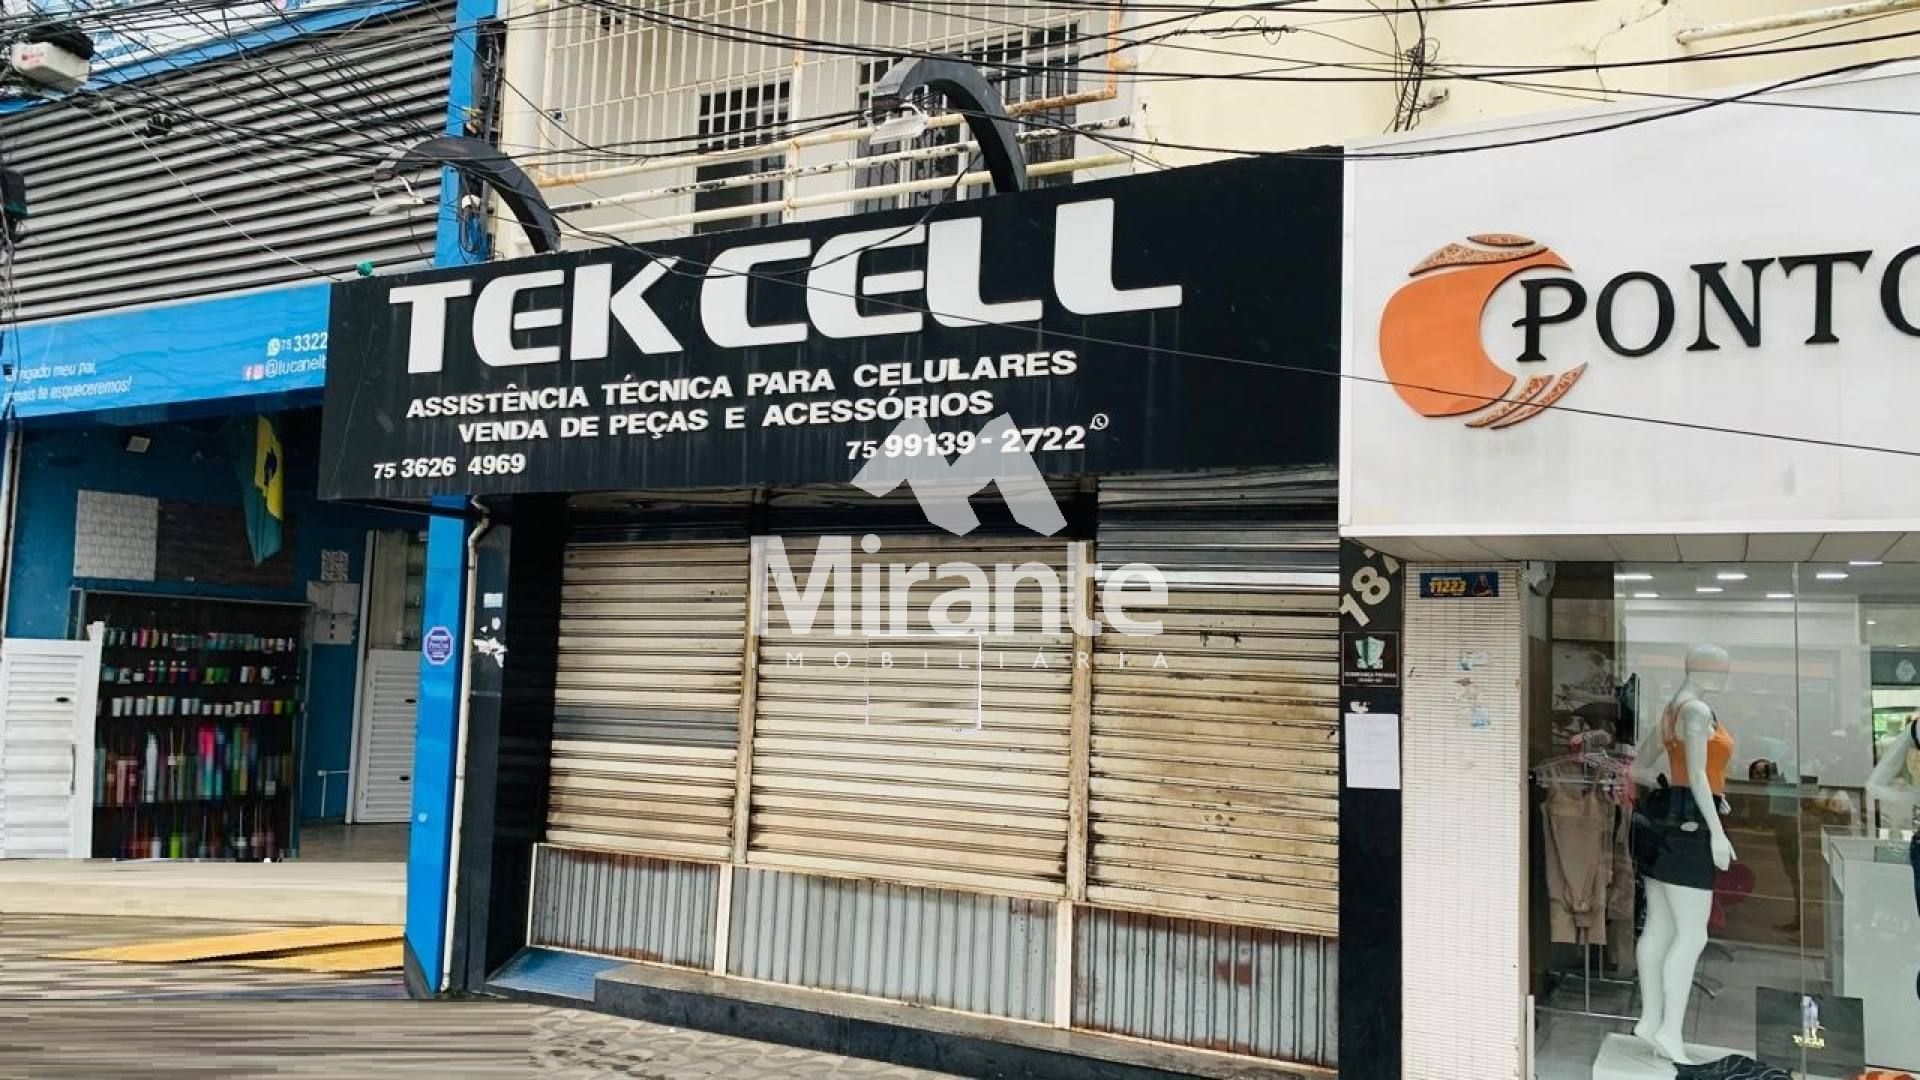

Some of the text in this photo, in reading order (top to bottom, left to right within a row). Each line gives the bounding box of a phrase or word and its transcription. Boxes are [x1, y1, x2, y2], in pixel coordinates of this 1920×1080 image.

[406, 350, 1078, 418] ASSISTÊNCIA TÉCNICA PARA CELULARES
[459, 388, 994, 443] VENDA DE PEÇAS E ACESSÓRIOS
[373, 453, 526, 480] 75 3626 4969
[846, 440, 877, 460] 75
